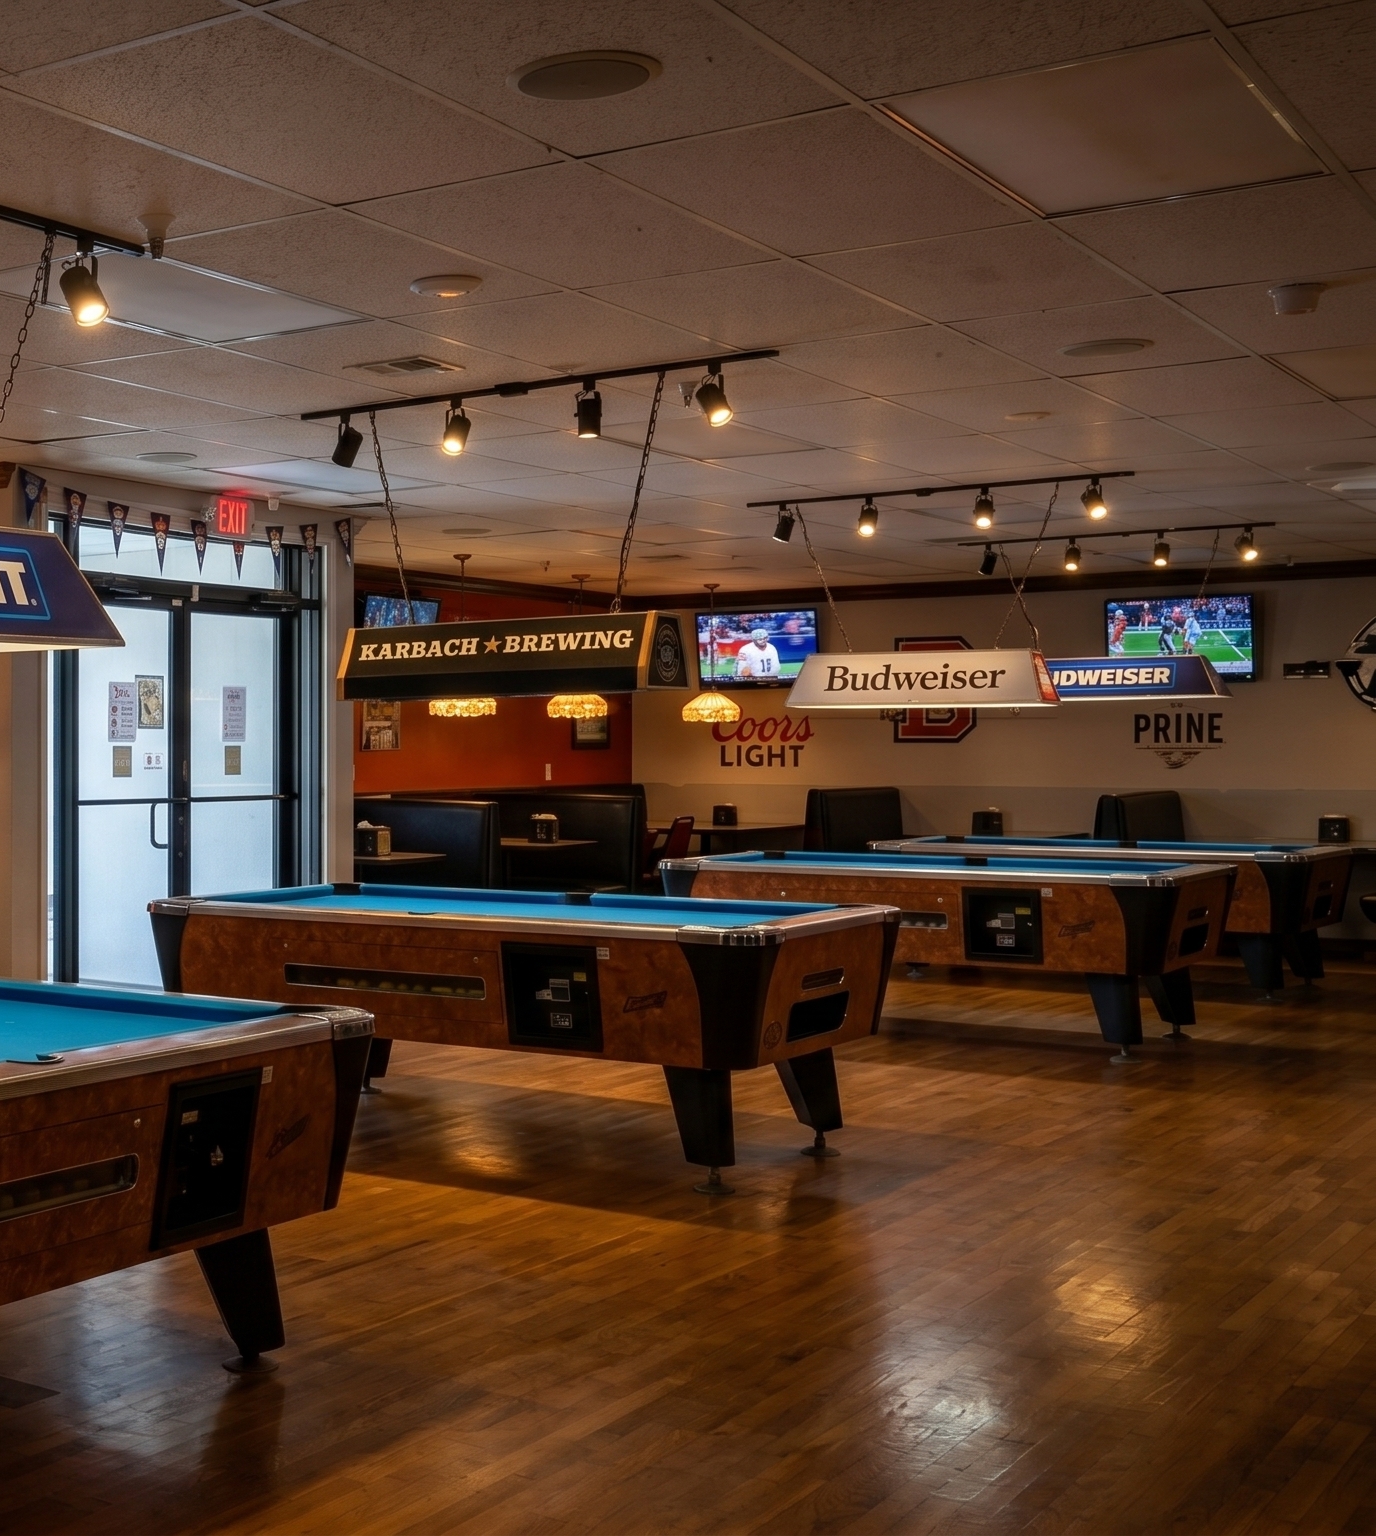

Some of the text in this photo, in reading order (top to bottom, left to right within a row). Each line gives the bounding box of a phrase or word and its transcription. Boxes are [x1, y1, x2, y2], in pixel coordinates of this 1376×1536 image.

[220, 500, 248, 534] EXIT
[359, 638, 479, 661] KARBACH
[503, 630, 634, 653] BREWING
[824, 664, 1006, 692] Budweiser
[1052, 668, 1170, 686] UDWEISER
[712, 705, 814, 742] Coors
[1134, 713, 1223, 743] PRINE
[720, 745, 804, 767] LIGHT
